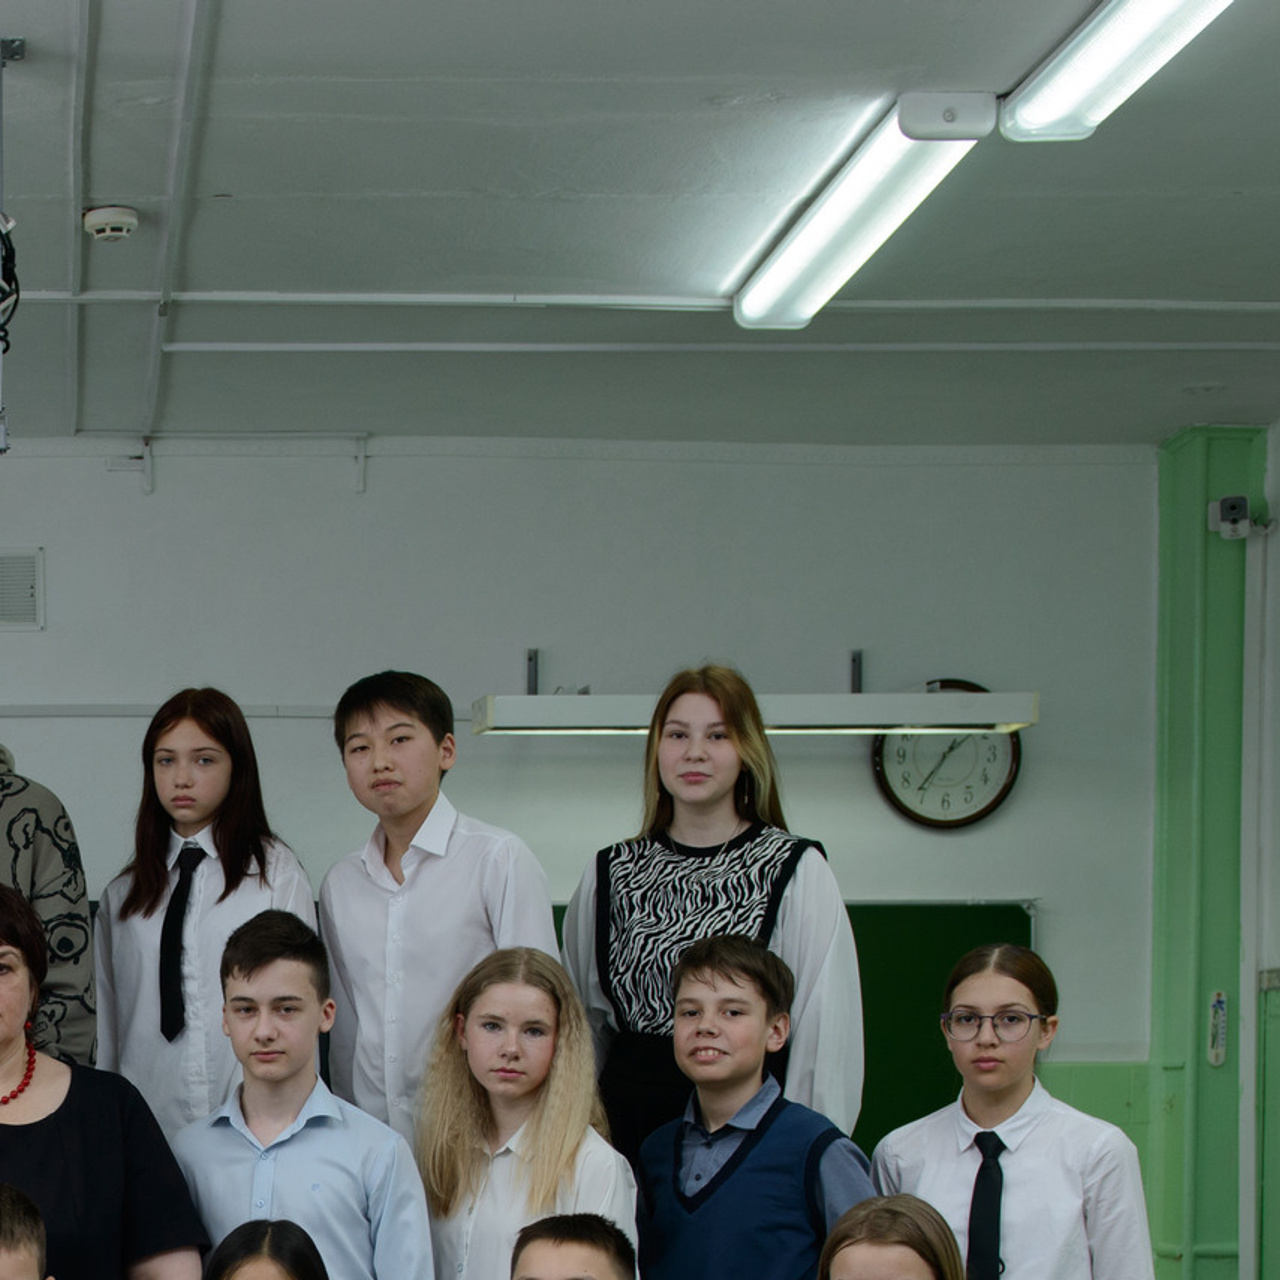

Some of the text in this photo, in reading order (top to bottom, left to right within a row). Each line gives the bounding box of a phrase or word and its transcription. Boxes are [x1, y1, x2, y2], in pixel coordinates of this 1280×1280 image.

[896, 747, 906, 765] 9
[987, 746, 997, 763] 3
[901, 771, 911, 788] 8
[980, 767, 989, 786] 4
[941, 792, 951, 810] 6
[964, 785, 975, 804] 5
